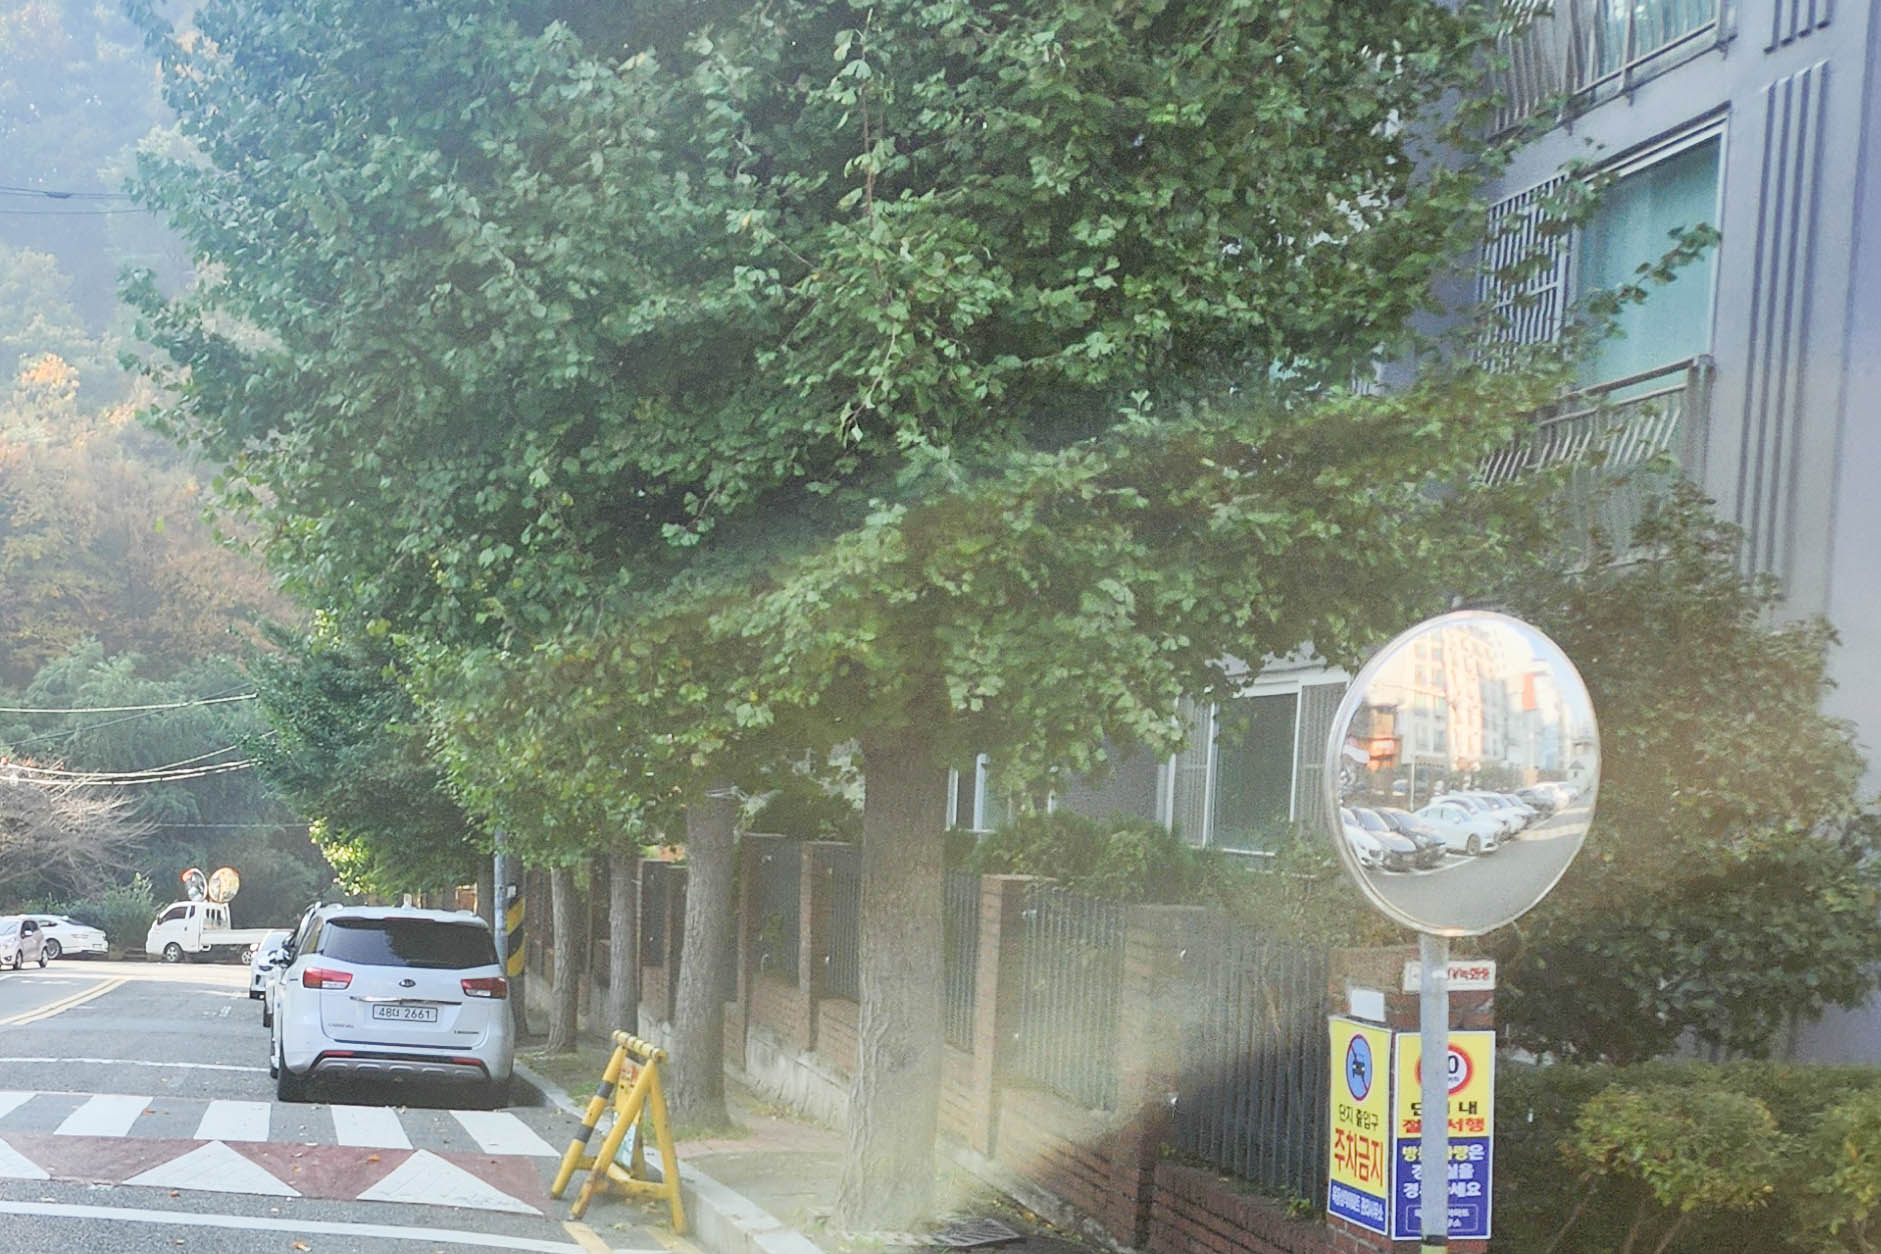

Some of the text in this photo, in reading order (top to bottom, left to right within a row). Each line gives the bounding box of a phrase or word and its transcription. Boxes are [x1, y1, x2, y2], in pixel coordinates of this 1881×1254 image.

[404, 1009, 431, 1020] 2661
[1338, 1103, 1354, 1123] 단지
[1458, 1100, 1478, 1115] 내
[1402, 1117, 1485, 1134] 절서행
[1333, 1127, 1384, 1188] 주차금지
